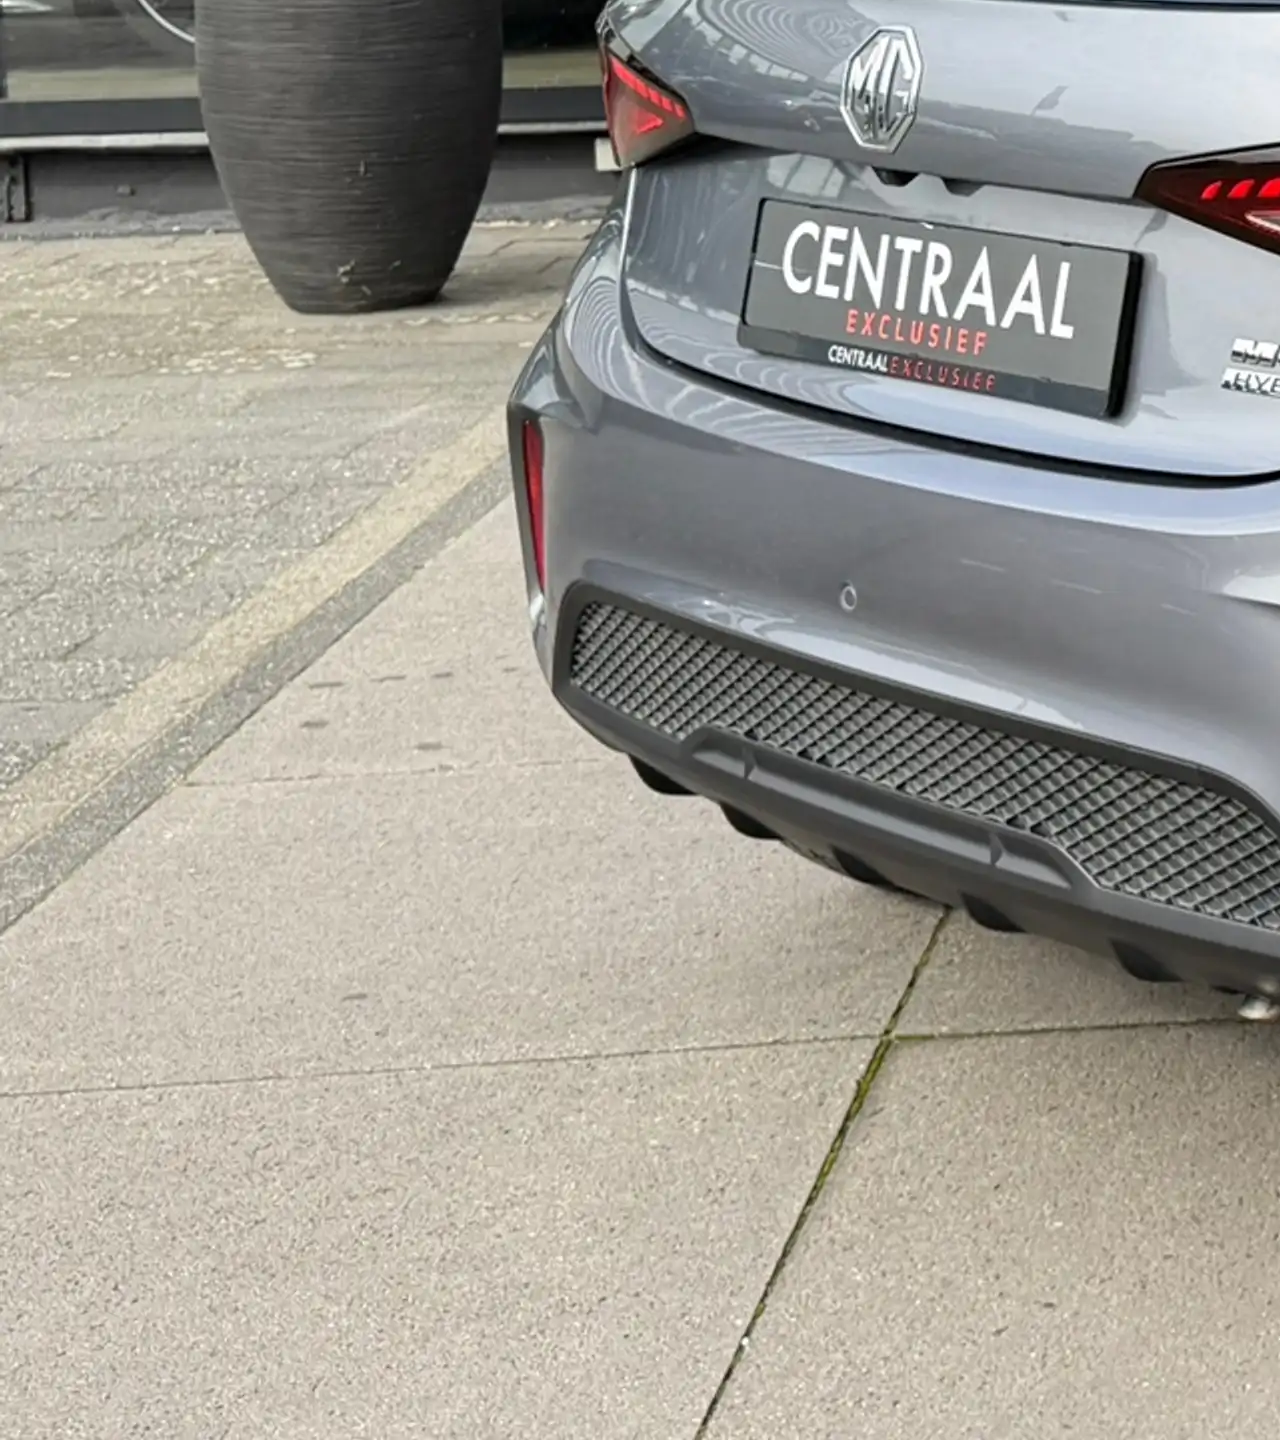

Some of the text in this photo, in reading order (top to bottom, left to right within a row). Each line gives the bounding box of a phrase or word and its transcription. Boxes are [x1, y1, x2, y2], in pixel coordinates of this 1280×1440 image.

[847, 33, 916, 142] MG
[782, 220, 1075, 339] CENTRAAL
[846, 308, 988, 356] EXCLUSIEF
